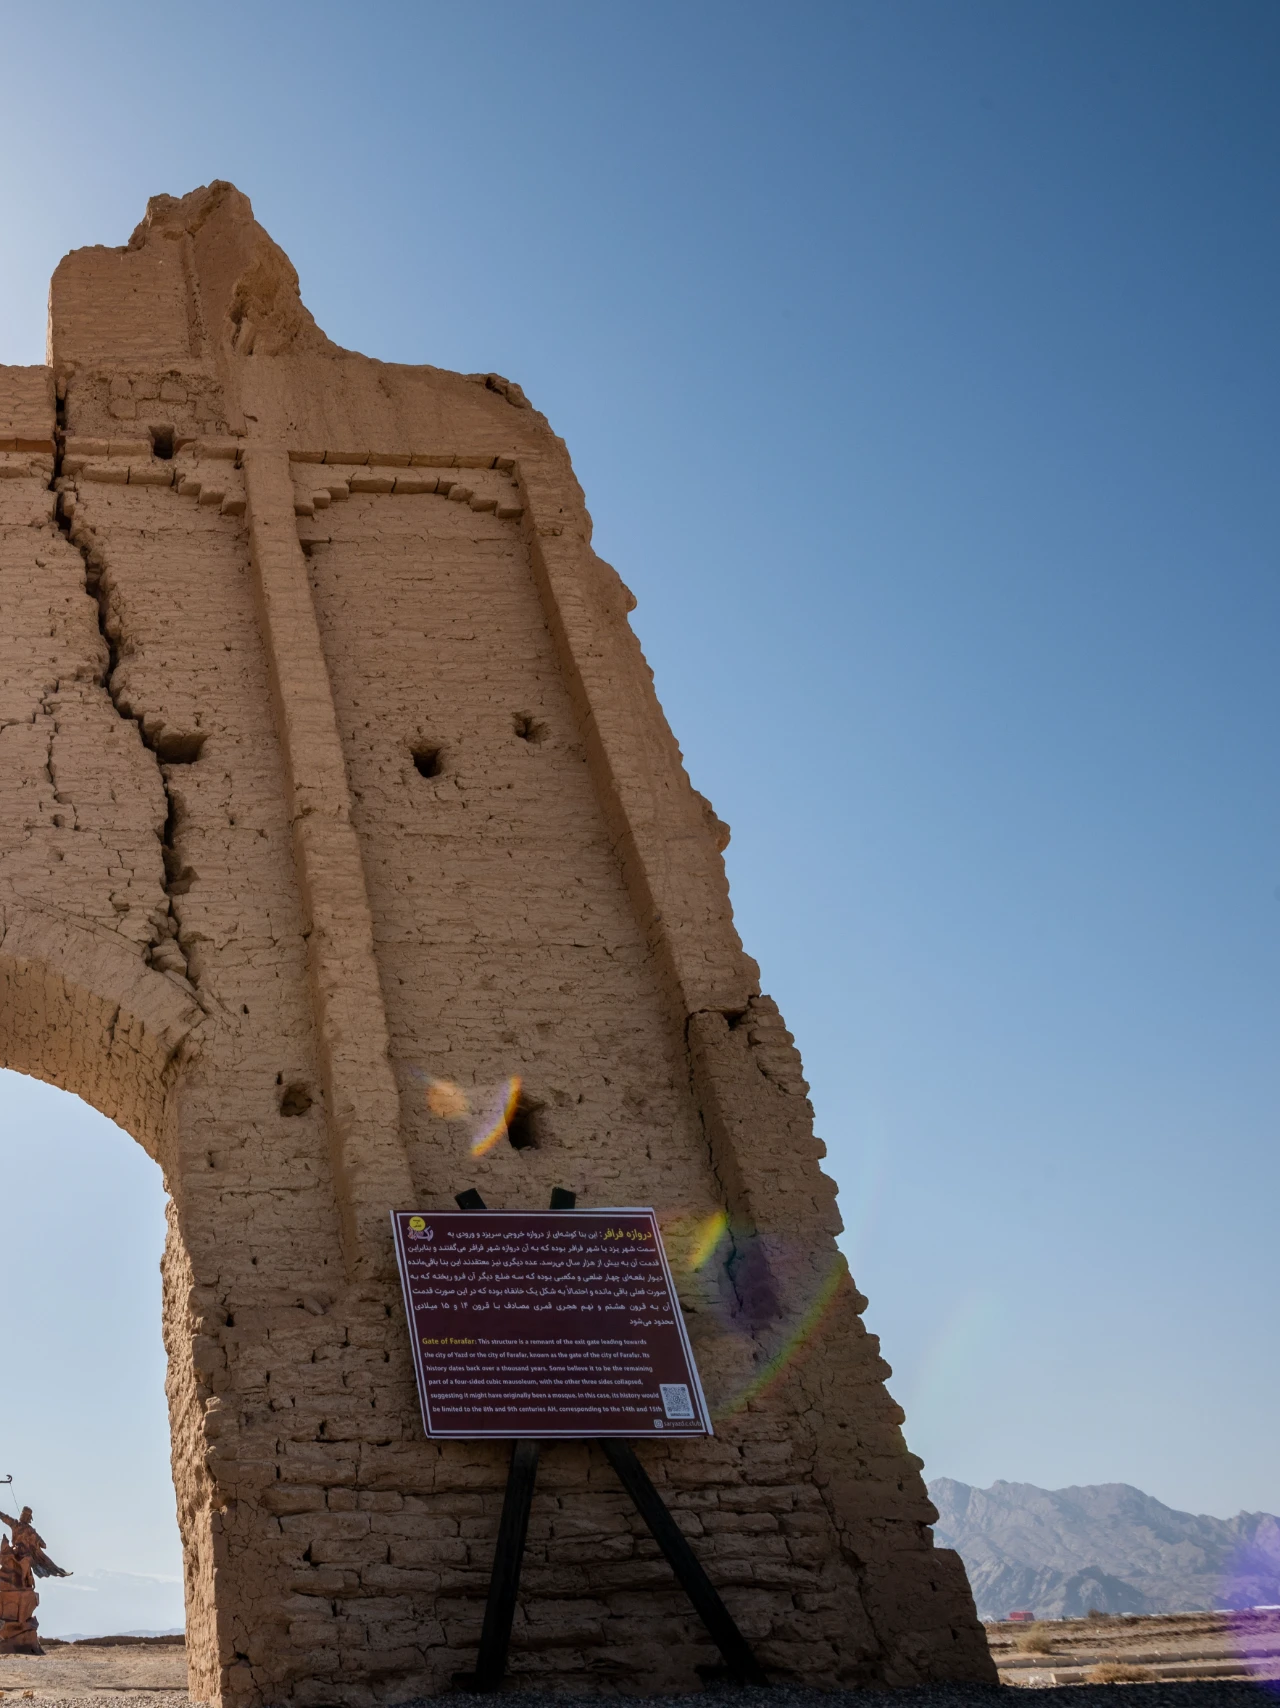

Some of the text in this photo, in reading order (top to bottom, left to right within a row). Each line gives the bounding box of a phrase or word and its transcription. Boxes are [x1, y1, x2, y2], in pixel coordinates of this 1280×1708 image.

[503, 1231, 525, 1239] خروجی
[526, 1230, 545, 1239] دروازه
[588, 1231, 598, 1239] این
[626, 1229, 652, 1240] دروازه
[407, 1244, 432, 1253] بنابراین
[468, 1244, 484, 1253] فرافر
[486, 1245, 501, 1253] شهر
[501, 1244, 520, 1253] دروازه
[521, 1243, 529, 1253] آن
[568, 1245, 584, 1253] فرافر
[585, 1245, 600, 1253] شهر
[600, 1245, 608, 1253] یا
[609, 1246, 620, 1254] یزد
[621, 1246, 636, 1254] شهر
[439, 1258, 449, 1267] بنا
[450, 1258, 462, 1267] این
[491, 1259, 502, 1267] نیز
[502, 1257, 524, 1267] دیگری
[565, 1259, 581, 1267] سال
[582, 1259, 596, 1268] هزار
[603, 1259, 620, 1268] بیش
[630, 1258, 638, 1268] آن
[432, 1273, 453, 1281] ریخته
[454, 1272, 466, 1281] فرو
[467, 1272, 476, 1281] آن
[477, 1271, 493, 1281] دیگر
[495, 1273, 510, 1282] ضلع
[525, 1272, 535, 1280] که
[537, 1274, 553, 1282] بوده
[553, 1272, 576, 1282] مکعبی
[582, 1273, 603, 1282] ضلعی
[604, 1273, 620, 1282] چهار
[647, 1274, 664, 1282] دیوار
[434, 1288, 455, 1296] صورت
[457, 1287, 468, 1296] این
[526, 1287, 538, 1296] یک
[539, 1287, 557, 1296] شکل
[613, 1288, 628, 1297] باقی
[630, 1288, 645, 1297] فعلی
[646, 1289, 667, 1297] صورت
[415, 1302, 438, 1311] میلادی
[472, 1301, 490, 1311] قرون
[493, 1302, 501, 1310] با
[533, 1302, 552, 1311] قمری
[581, 1304, 594, 1312] نهم
[605, 1303, 626, 1312] هشتم
[630, 1302, 647, 1312] قرون
[663, 1302, 671, 1312] آن
[440, 1337, 448, 1345] of
[469, 1392, 488, 1400] might
[503, 1392, 531, 1400] originally
